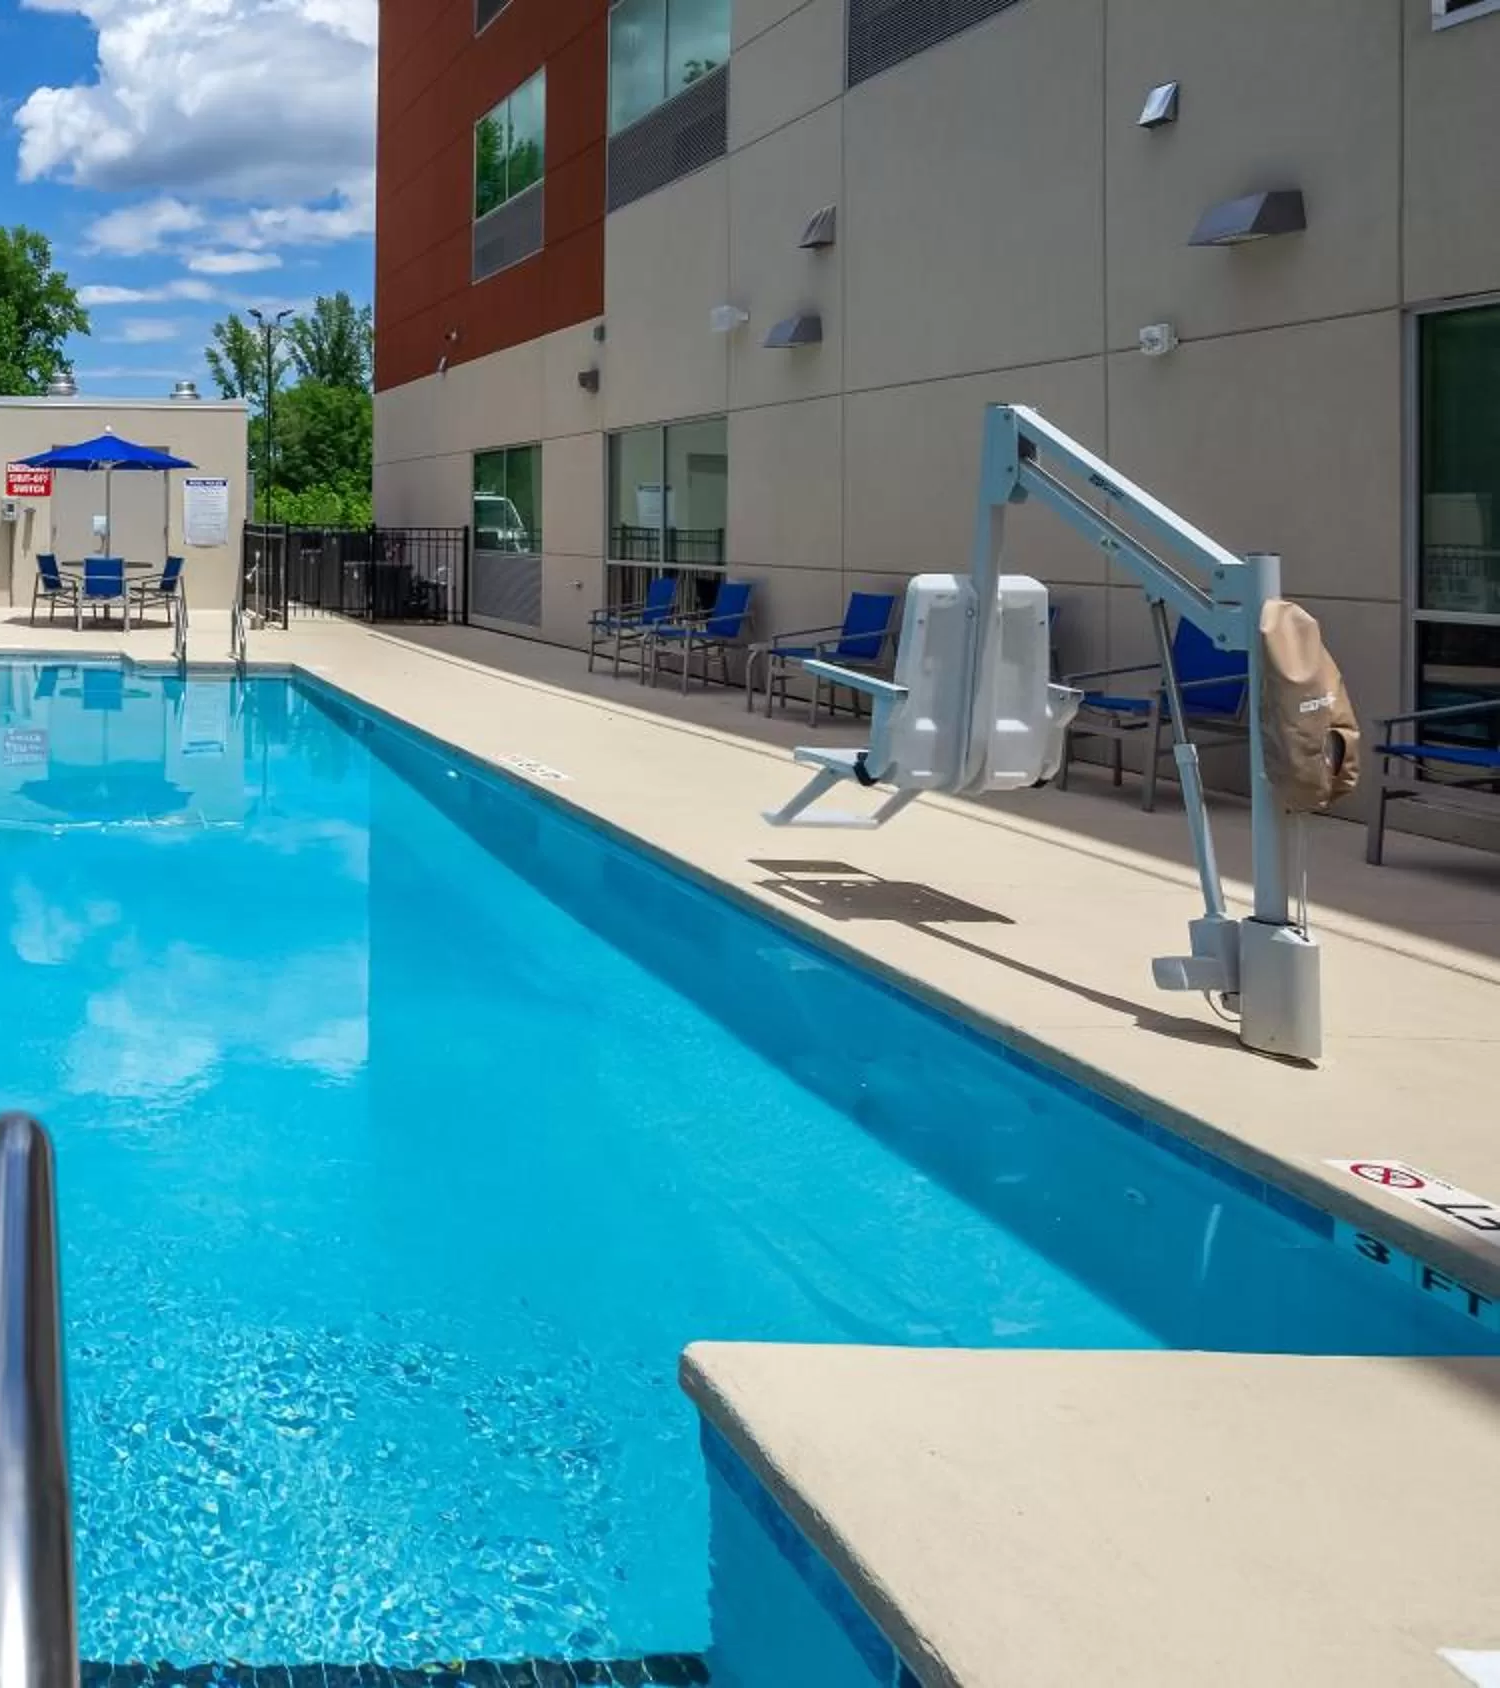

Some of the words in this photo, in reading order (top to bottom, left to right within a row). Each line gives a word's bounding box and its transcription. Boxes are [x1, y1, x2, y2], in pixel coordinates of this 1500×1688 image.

[12, 484, 45, 493] SWITCH
[1354, 1231, 1391, 1265] 3
[1421, 1263, 1493, 1318] FT
